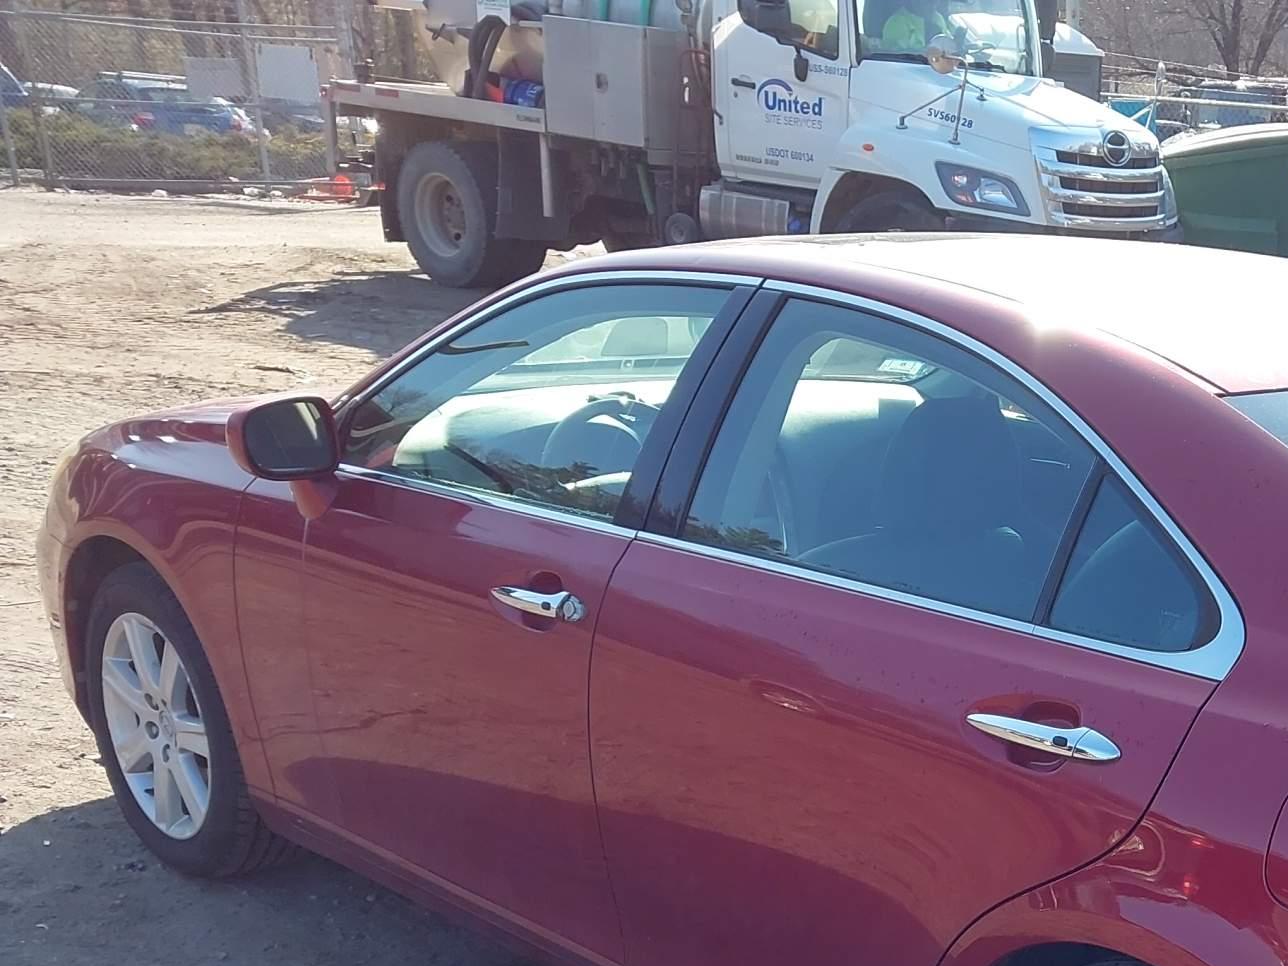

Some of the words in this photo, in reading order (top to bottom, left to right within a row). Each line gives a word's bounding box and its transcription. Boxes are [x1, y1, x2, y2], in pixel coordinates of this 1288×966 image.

[764, 90, 823, 117] United
[765, 113, 781, 125] SITE
[783, 115, 823, 130] SERVICES
[927, 107, 973, 129] SVS6028
[765, 147, 789, 159] USDOT
